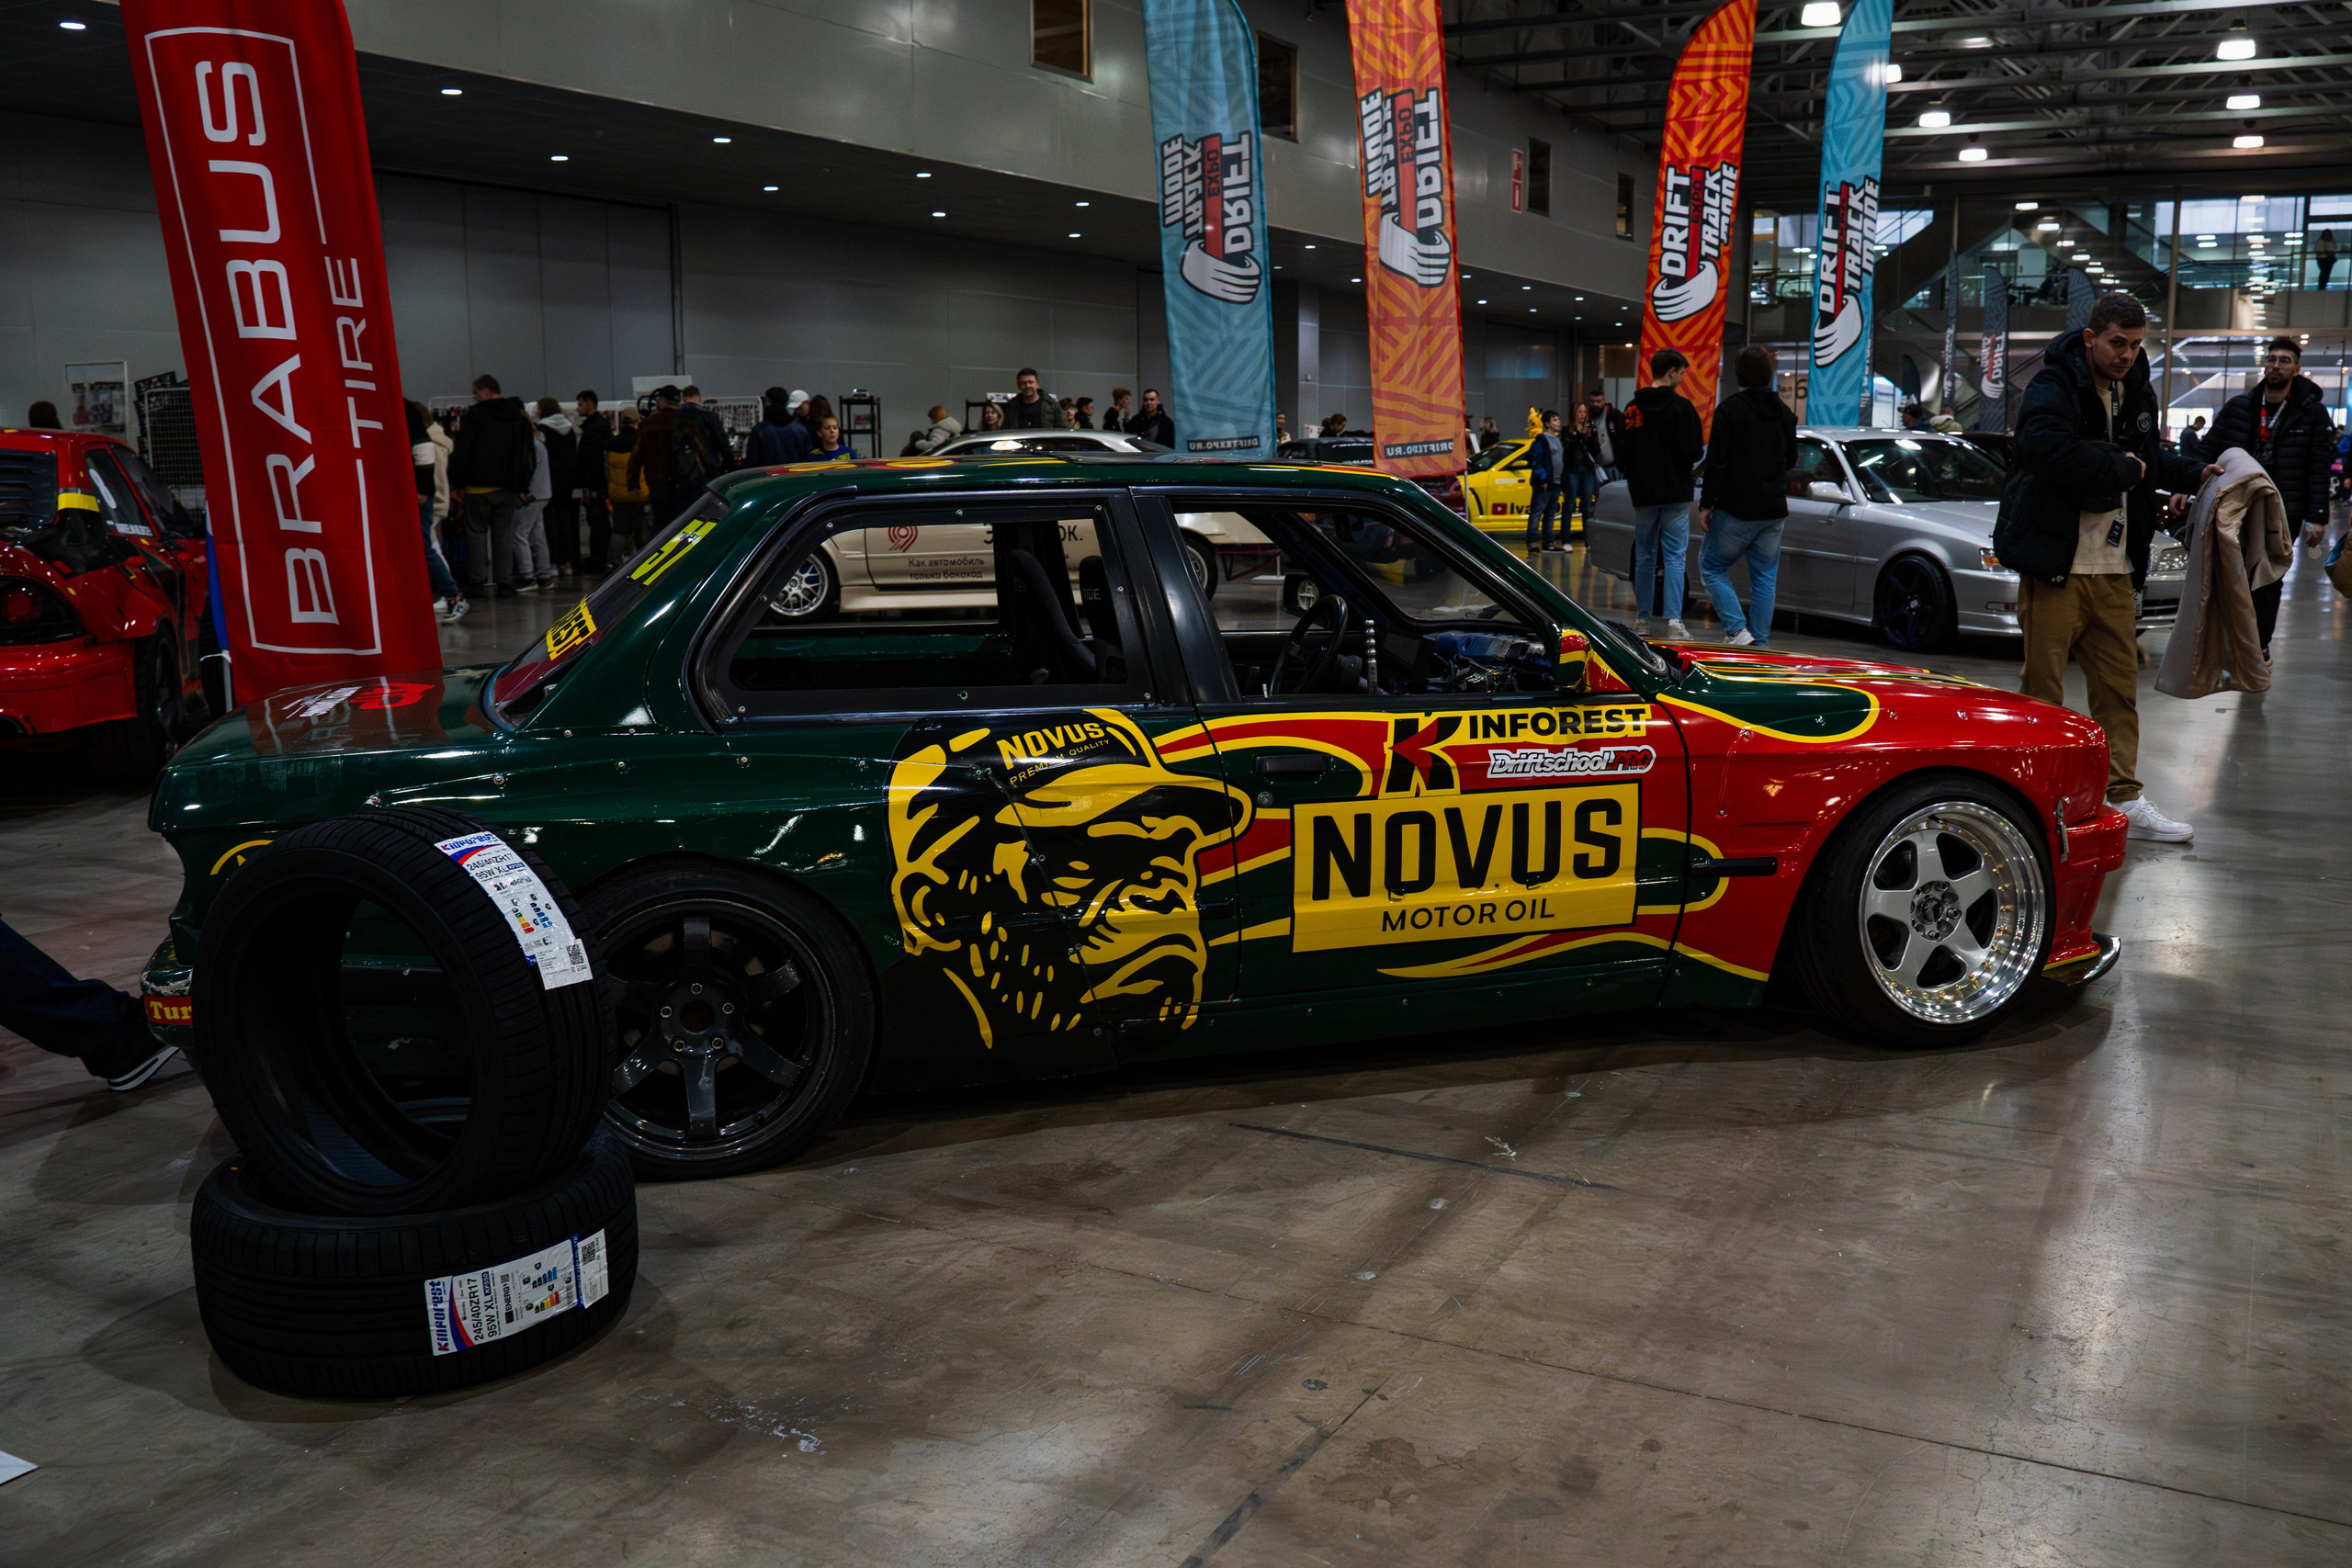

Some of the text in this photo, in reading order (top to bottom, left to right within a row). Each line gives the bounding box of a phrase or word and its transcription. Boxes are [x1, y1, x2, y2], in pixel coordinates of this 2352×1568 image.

[1659, 166, 1691, 277] DRIFT
[1702, 170, 1723, 258] TRACK
[1844, 186, 1865, 289] TRACK
[1818, 184, 1841, 314] DRIFT
[194, 60, 341, 626] BRABUS
[324, 256, 384, 433] TIRE
[909, 558, 984, 567] Как автомобиль
[996, 723, 1105, 771] NOVUS
[1010, 739, 1110, 788] PREMIM QUALITY
[1313, 798, 1623, 901] NOVUS
[1382, 897, 1555, 931] MOTOR OIL
[150, 1000, 192, 1021] Tur
[468, 1278, 484, 1341] 245/40ZR17
[483, 1293, 494, 1314] XL
[486, 1314, 498, 1337] 95W
